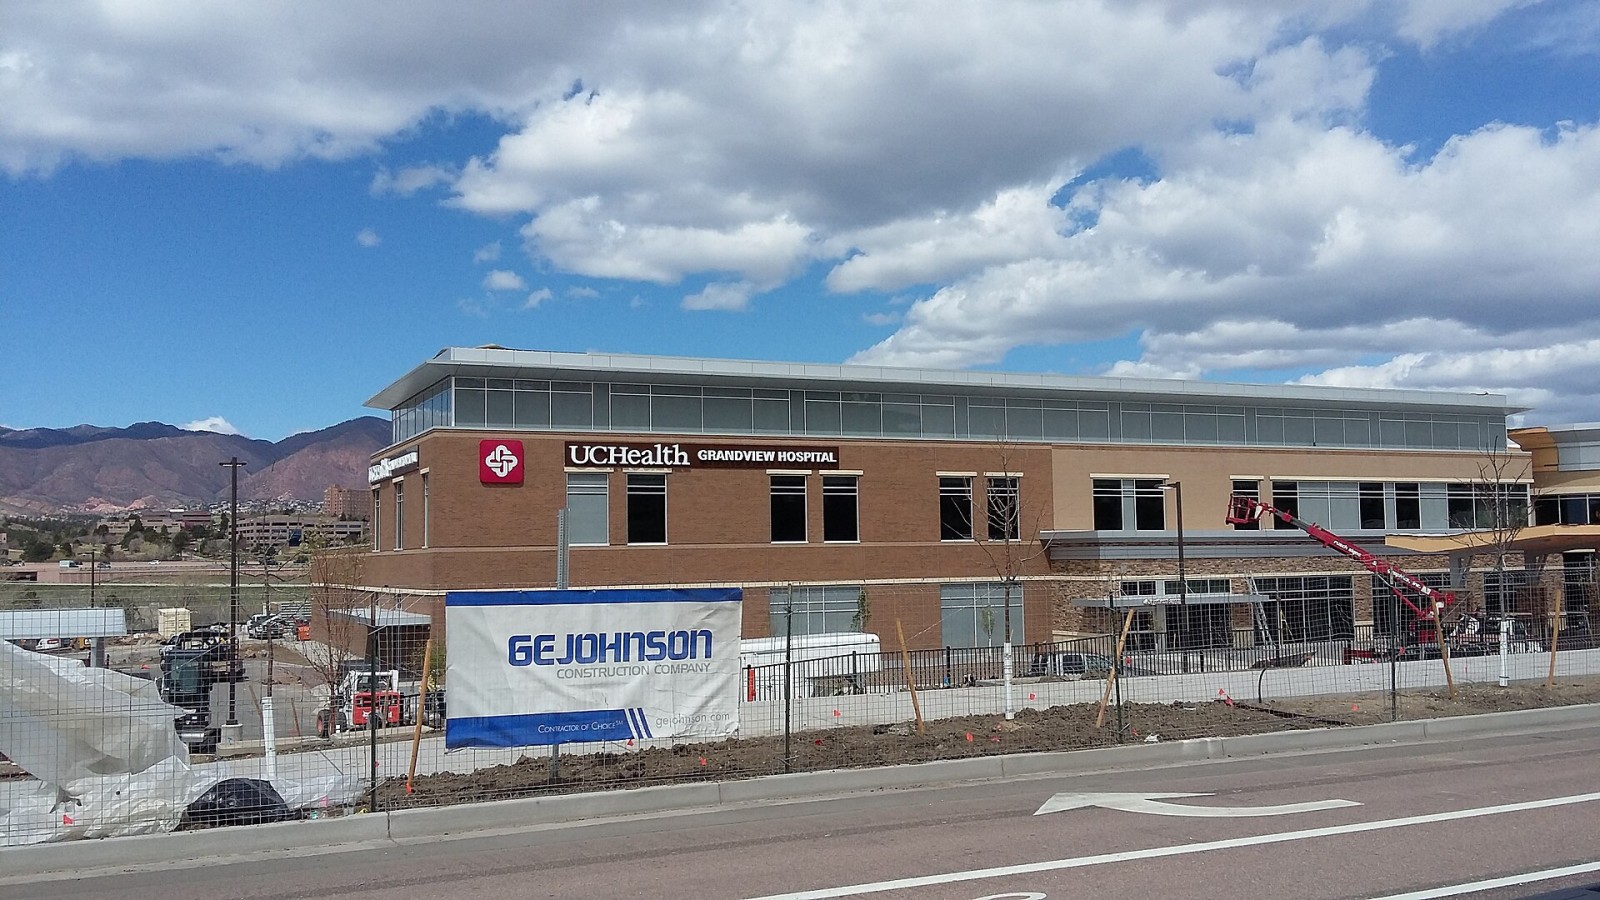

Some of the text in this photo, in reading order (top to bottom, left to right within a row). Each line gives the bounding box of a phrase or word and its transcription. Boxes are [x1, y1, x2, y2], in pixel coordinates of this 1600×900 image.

[568, 443, 837, 466] UCHealth GRANDVIEW HOSPITAL
[556, 662, 712, 680] CONSTRUCTION COMPANY
[655, 713, 730, 729] gejohnson.com
